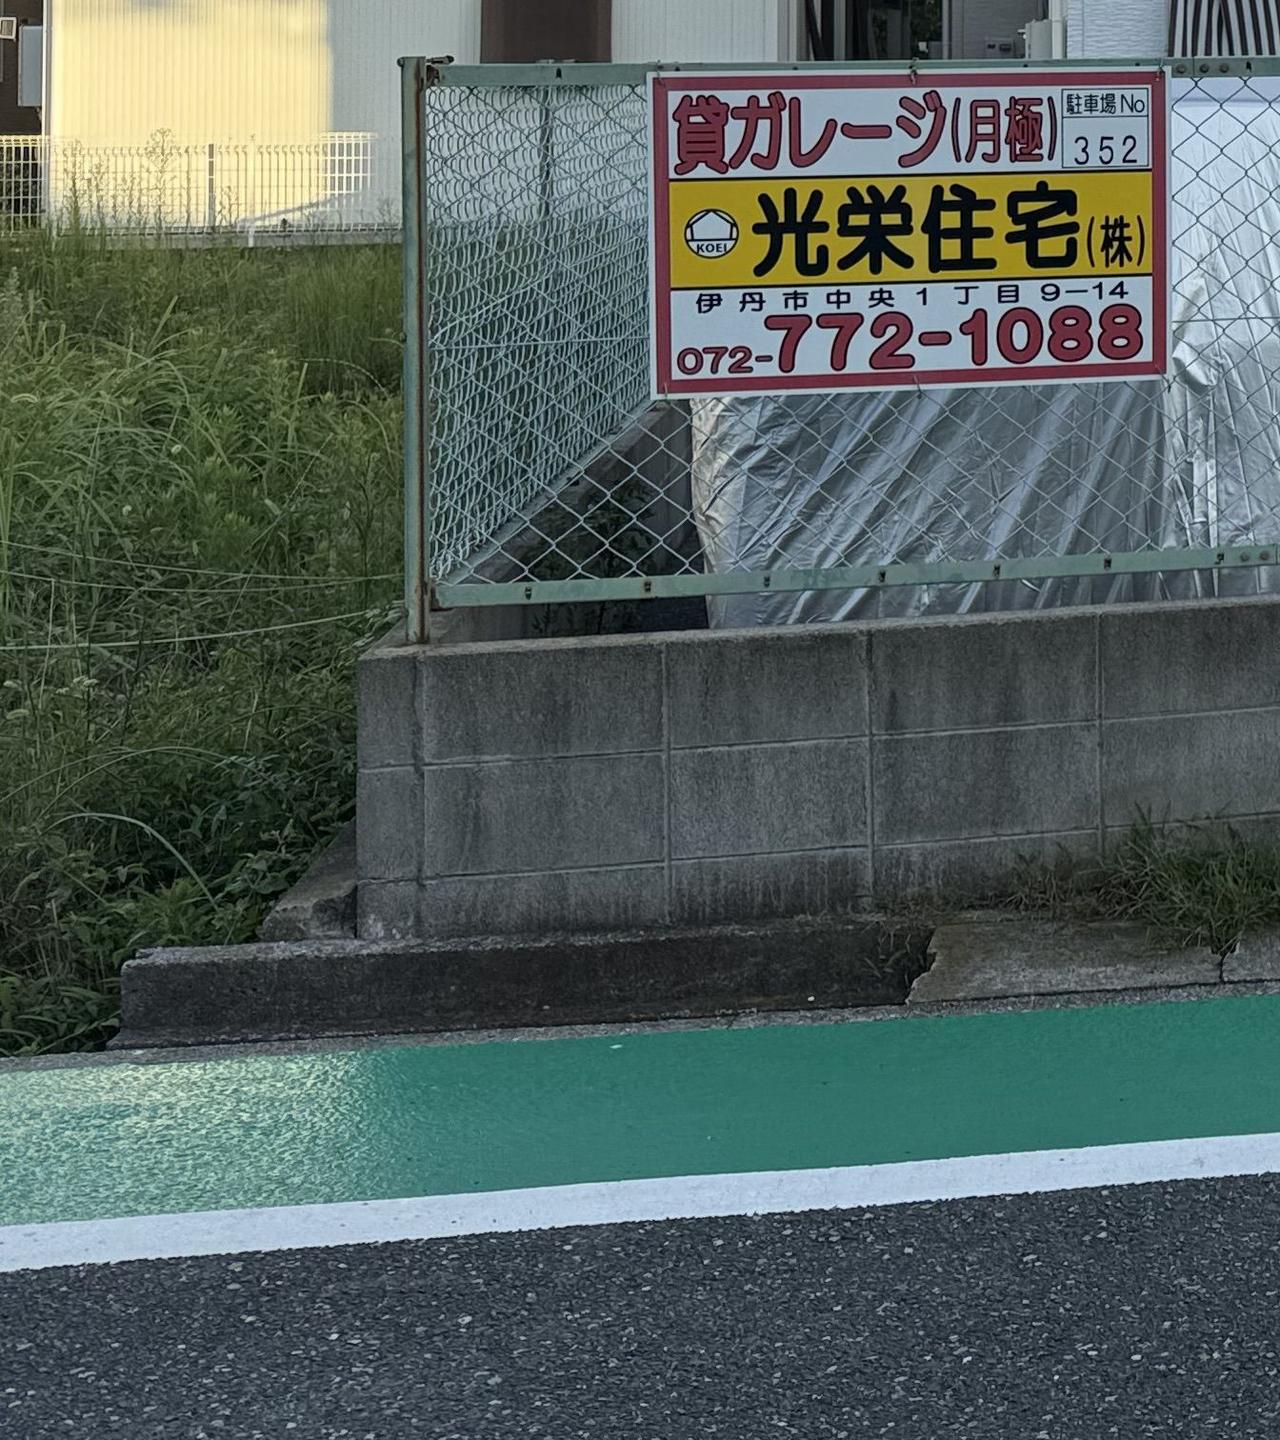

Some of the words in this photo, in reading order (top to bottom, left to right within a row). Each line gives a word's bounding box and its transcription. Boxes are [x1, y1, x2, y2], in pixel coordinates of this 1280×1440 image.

[1074, 135, 1138, 165] 352
[696, 243, 727, 253] KOEI
[676, 303, 1143, 375] 072-772-1088
